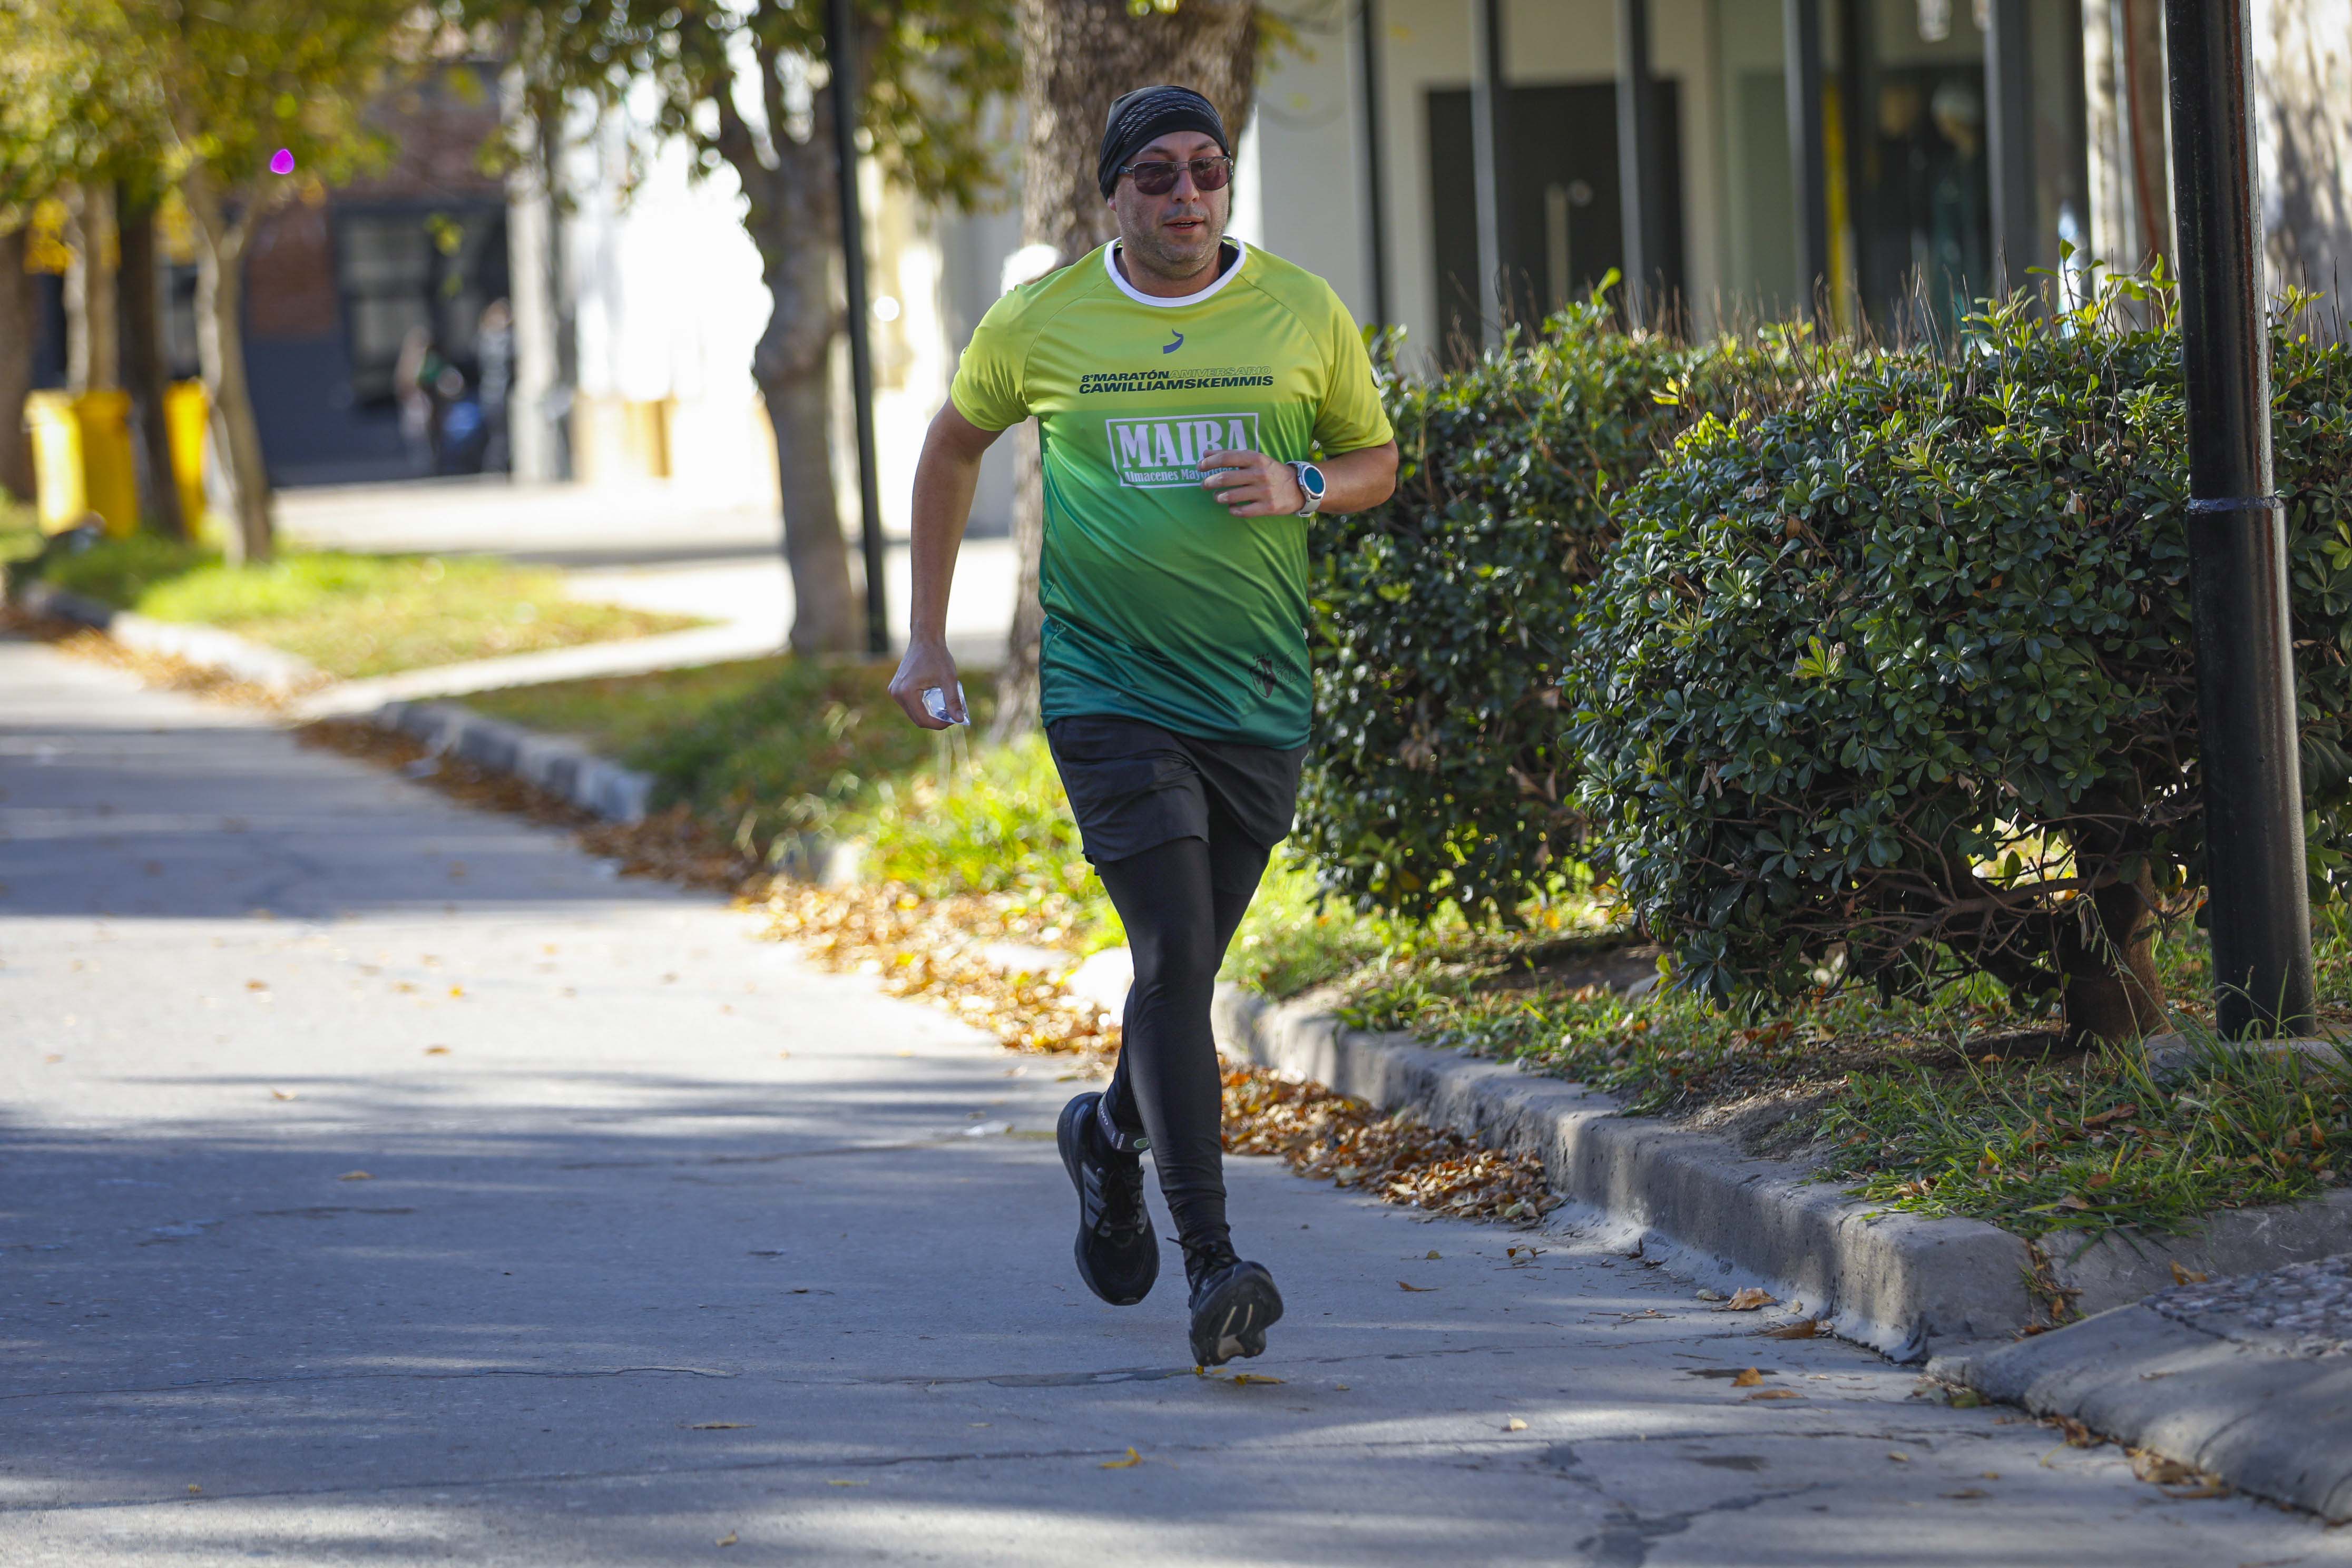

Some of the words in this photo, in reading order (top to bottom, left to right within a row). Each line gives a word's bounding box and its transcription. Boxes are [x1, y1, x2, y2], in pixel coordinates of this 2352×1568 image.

[1169, 366, 1272, 379] ANIVERSARIO
[1079, 376, 1273, 394] CAWILLIAMSKEMMIS
[1124, 471, 1179, 482] Almacenes
